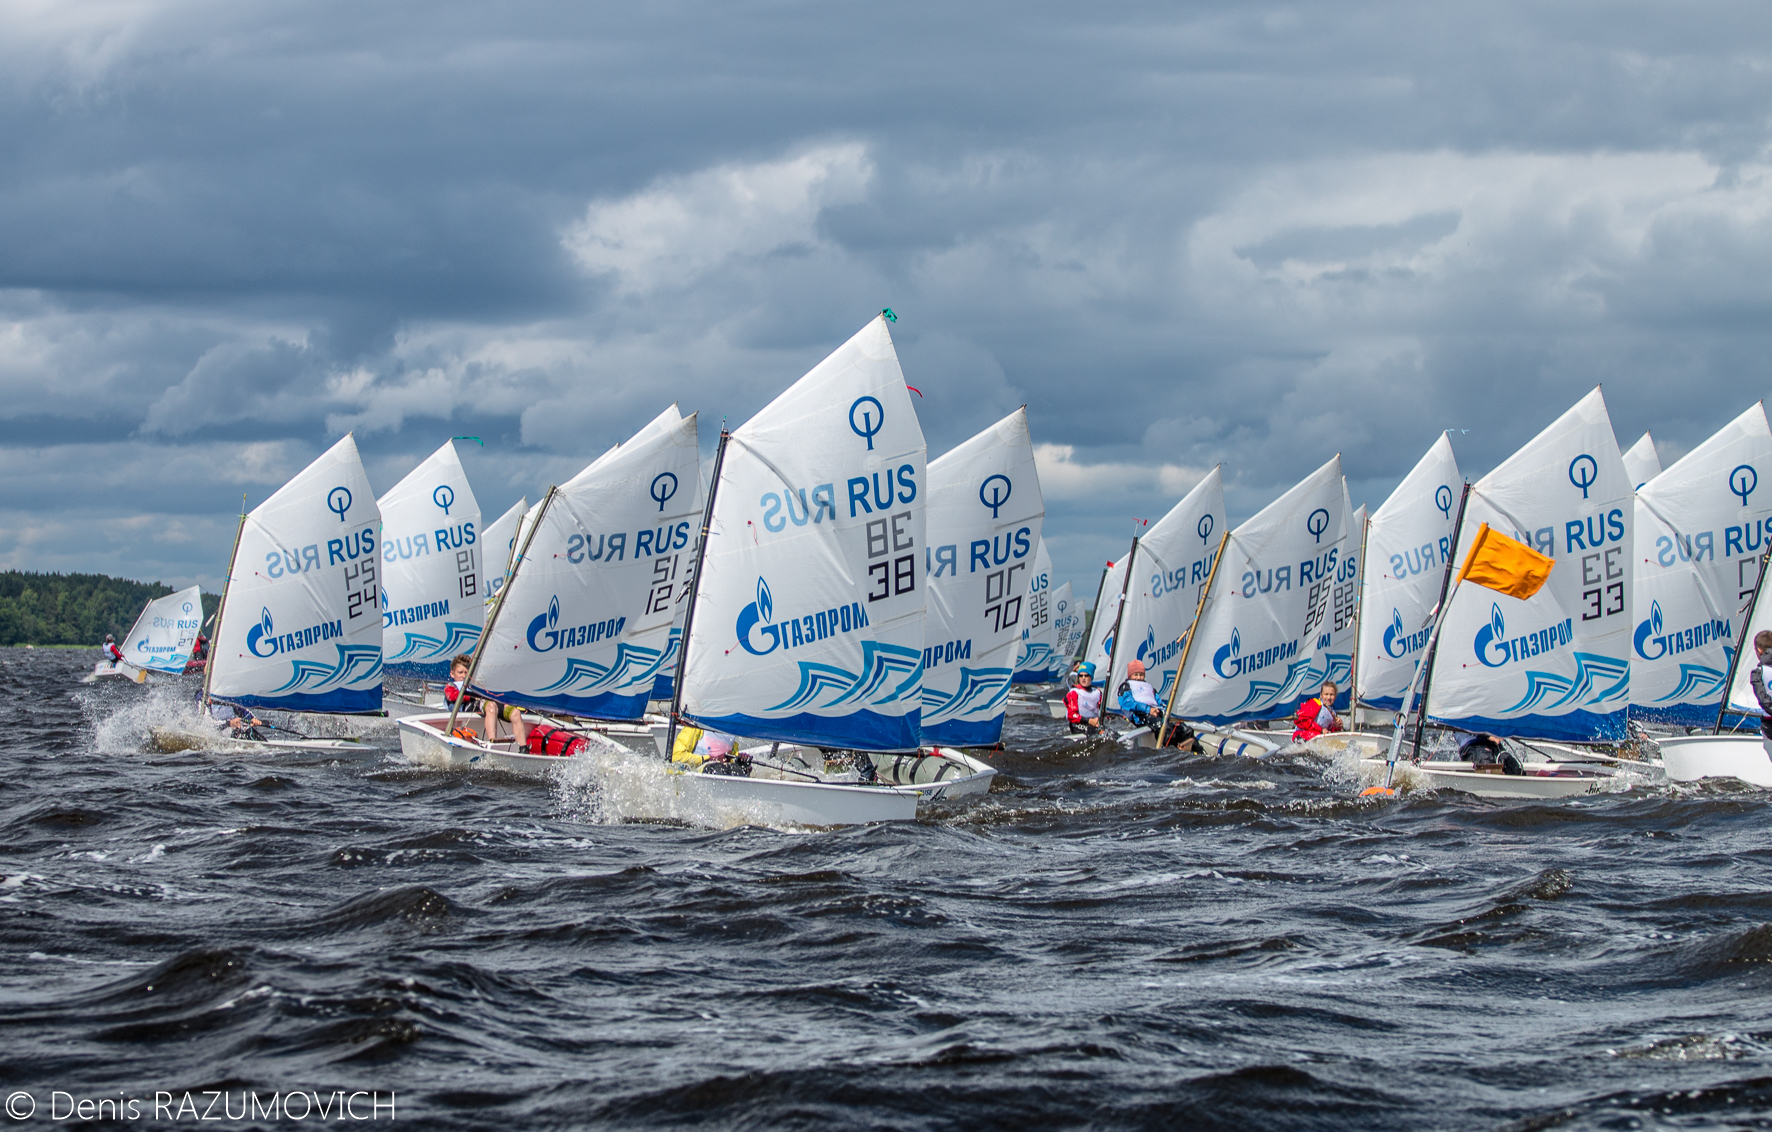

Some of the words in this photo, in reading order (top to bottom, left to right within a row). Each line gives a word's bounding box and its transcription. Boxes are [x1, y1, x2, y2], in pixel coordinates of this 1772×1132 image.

[847, 464, 917, 518] RUS
[327, 528, 375, 566] RUS
[434, 522, 476, 552] RUS
[634, 521, 690, 559] RUS
[1566, 509, 1625, 553] RUS
[970, 527, 1030, 573] RUS
[1191, 550, 1218, 585] RU
[1300, 548, 1338, 587] RUS
[459, 573, 476, 599] 19
[868, 553, 915, 603] 38
[1029, 573, 1049, 594] US
[1334, 557, 1356, 585] US
[347, 584, 378, 620] 24
[393, 599, 450, 626] ГАЗПРОМ
[645, 584, 674, 615] 12
[984, 595, 1022, 633] 70
[1582, 581, 1624, 621] 33
[177, 620, 198, 629] RUS
[780, 600, 870, 650] ГАЗПРОМ
[1031, 607, 1048, 629] 35
[1055, 615, 1072, 629] RUS
[1303, 600, 1327, 637] 28
[1334, 604, 1354, 633] 59
[278, 619, 343, 654] ГАЗПРОМ
[1068, 631, 1081, 641] US
[1668, 618, 1732, 656] ГАЗПРОМ
[923, 639, 972, 669] ПРОМ
[1242, 639, 1298, 675] ГАЗПРОМ
